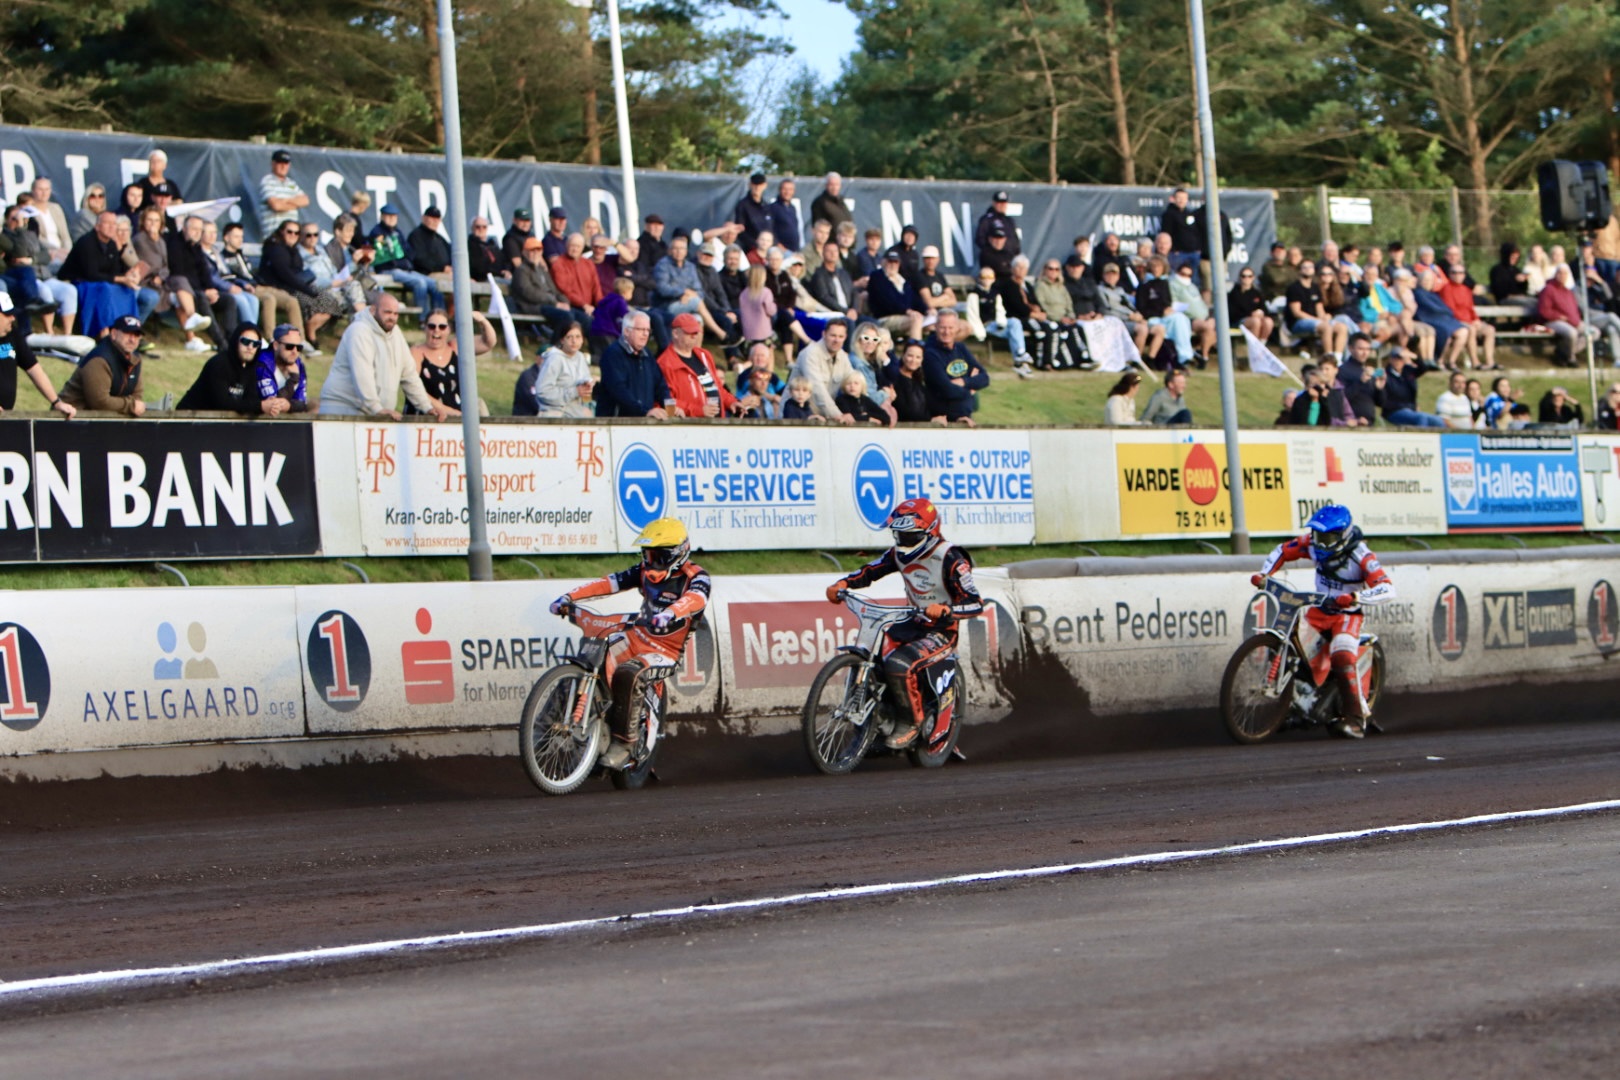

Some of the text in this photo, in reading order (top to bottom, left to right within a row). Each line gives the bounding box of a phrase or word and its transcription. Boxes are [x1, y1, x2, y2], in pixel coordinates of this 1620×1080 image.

[415, 428, 465, 458] Hans
[672, 449, 814, 468] HENNE OUTRUP
[902, 450, 1031, 468] HENNE OUTRUP
[1357, 448, 1434, 467] Succes skaber
[107, 451, 295, 528] BANK
[440, 462, 536, 500] Trnsport
[675, 473, 815, 502] EL-SERVICE
[904, 473, 1033, 499] EL-SERVICE
[1124, 468, 1180, 491] VARDE
[1222, 468, 1285, 490] CNTER
[1359, 474, 1370, 493] vi
[1373, 479, 1421, 494] sammen
[1477, 462, 1534, 499] Halles
[1537, 462, 1578, 499] Auto
[385, 507, 593, 528] Kran-Grab-Ctainer-Køreplader
[731, 508, 817, 529] Kirchheiner
[956, 507, 1035, 525] Kirchheiner
[1176, 511, 1226, 527] 75 21 14
[497, 531, 533, 549] Outrup
[1022, 598, 1228, 644] Bent Pedersen
[1441, 587, 1461, 654] 1
[1484, 596, 1525, 646] XL
[1593, 582, 1614, 646] 1
[318, 614, 361, 702] 1
[461, 637, 577, 672] SPAREKA
[463, 682, 483, 701] for
[488, 681, 526, 701] Nørre
